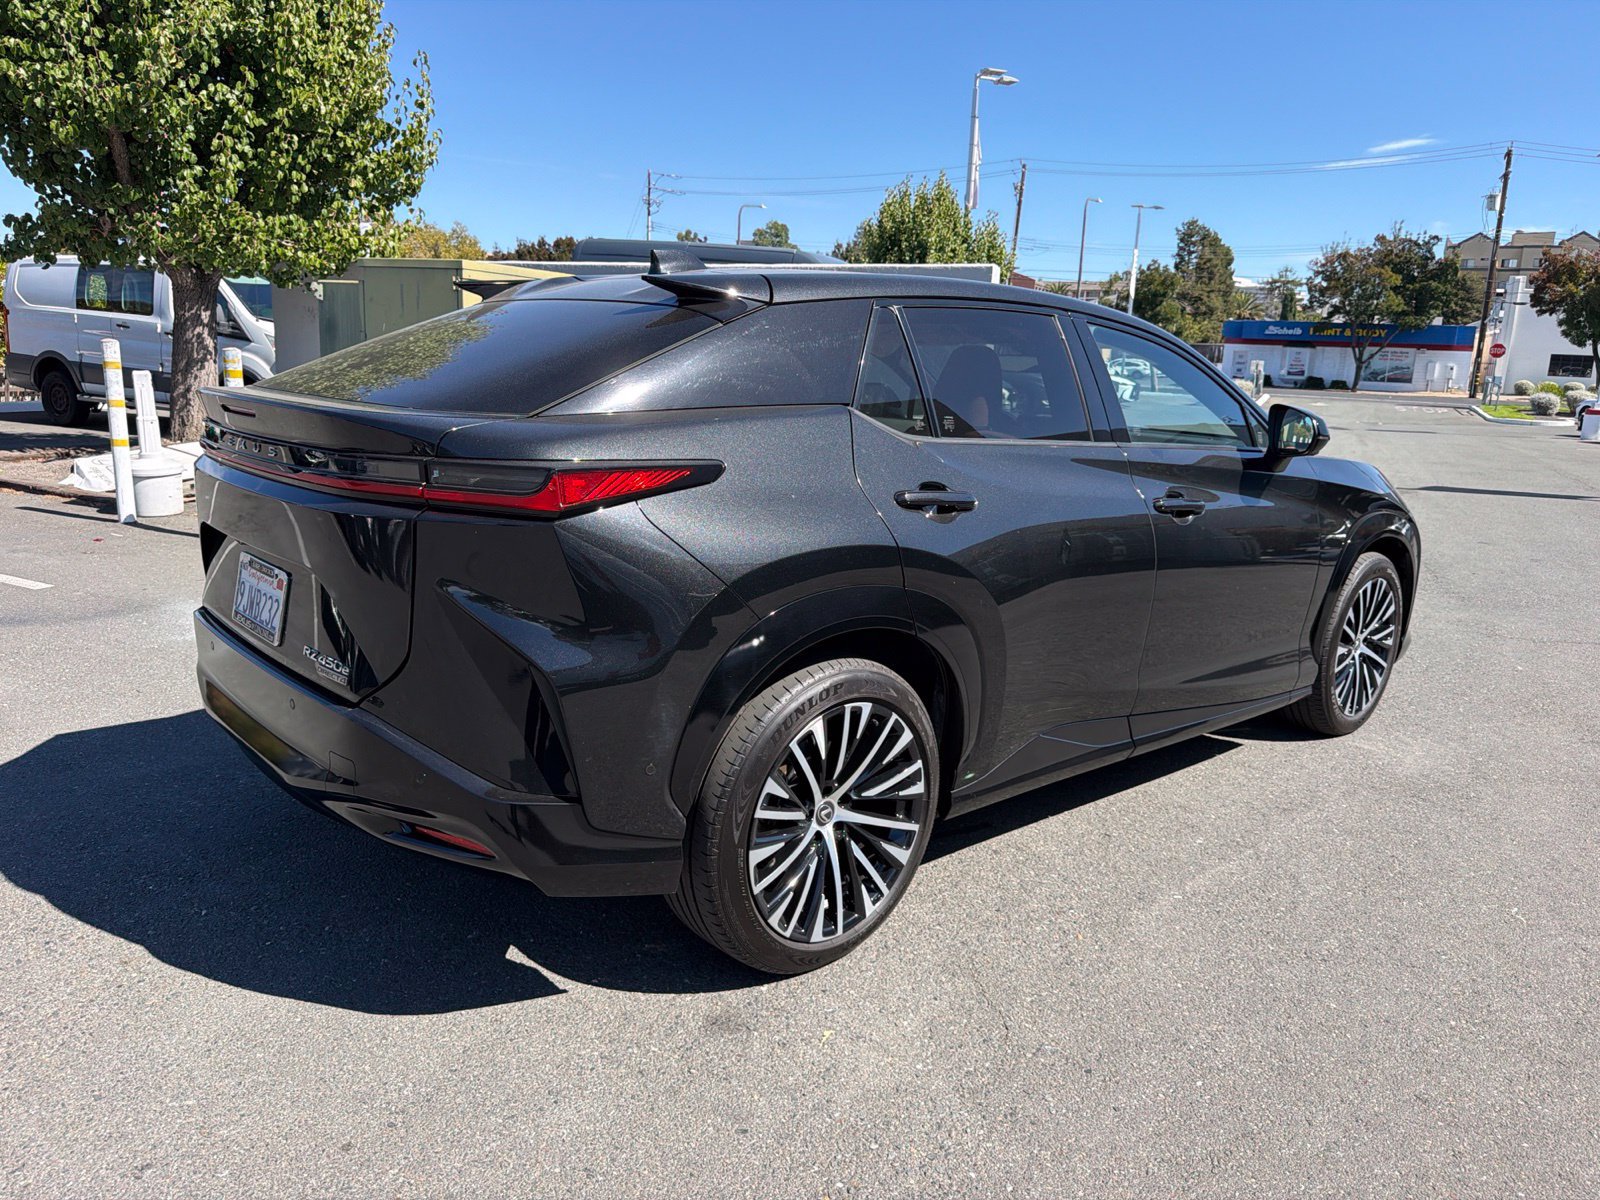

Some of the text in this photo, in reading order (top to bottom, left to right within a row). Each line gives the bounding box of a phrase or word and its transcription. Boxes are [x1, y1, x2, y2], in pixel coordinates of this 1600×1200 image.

[1490, 347, 1506, 355] STOP
[1394, 405, 1448, 414] STOP
[224, 432, 279, 457] EXUS
[770, 682, 845, 745] DUNLOP
